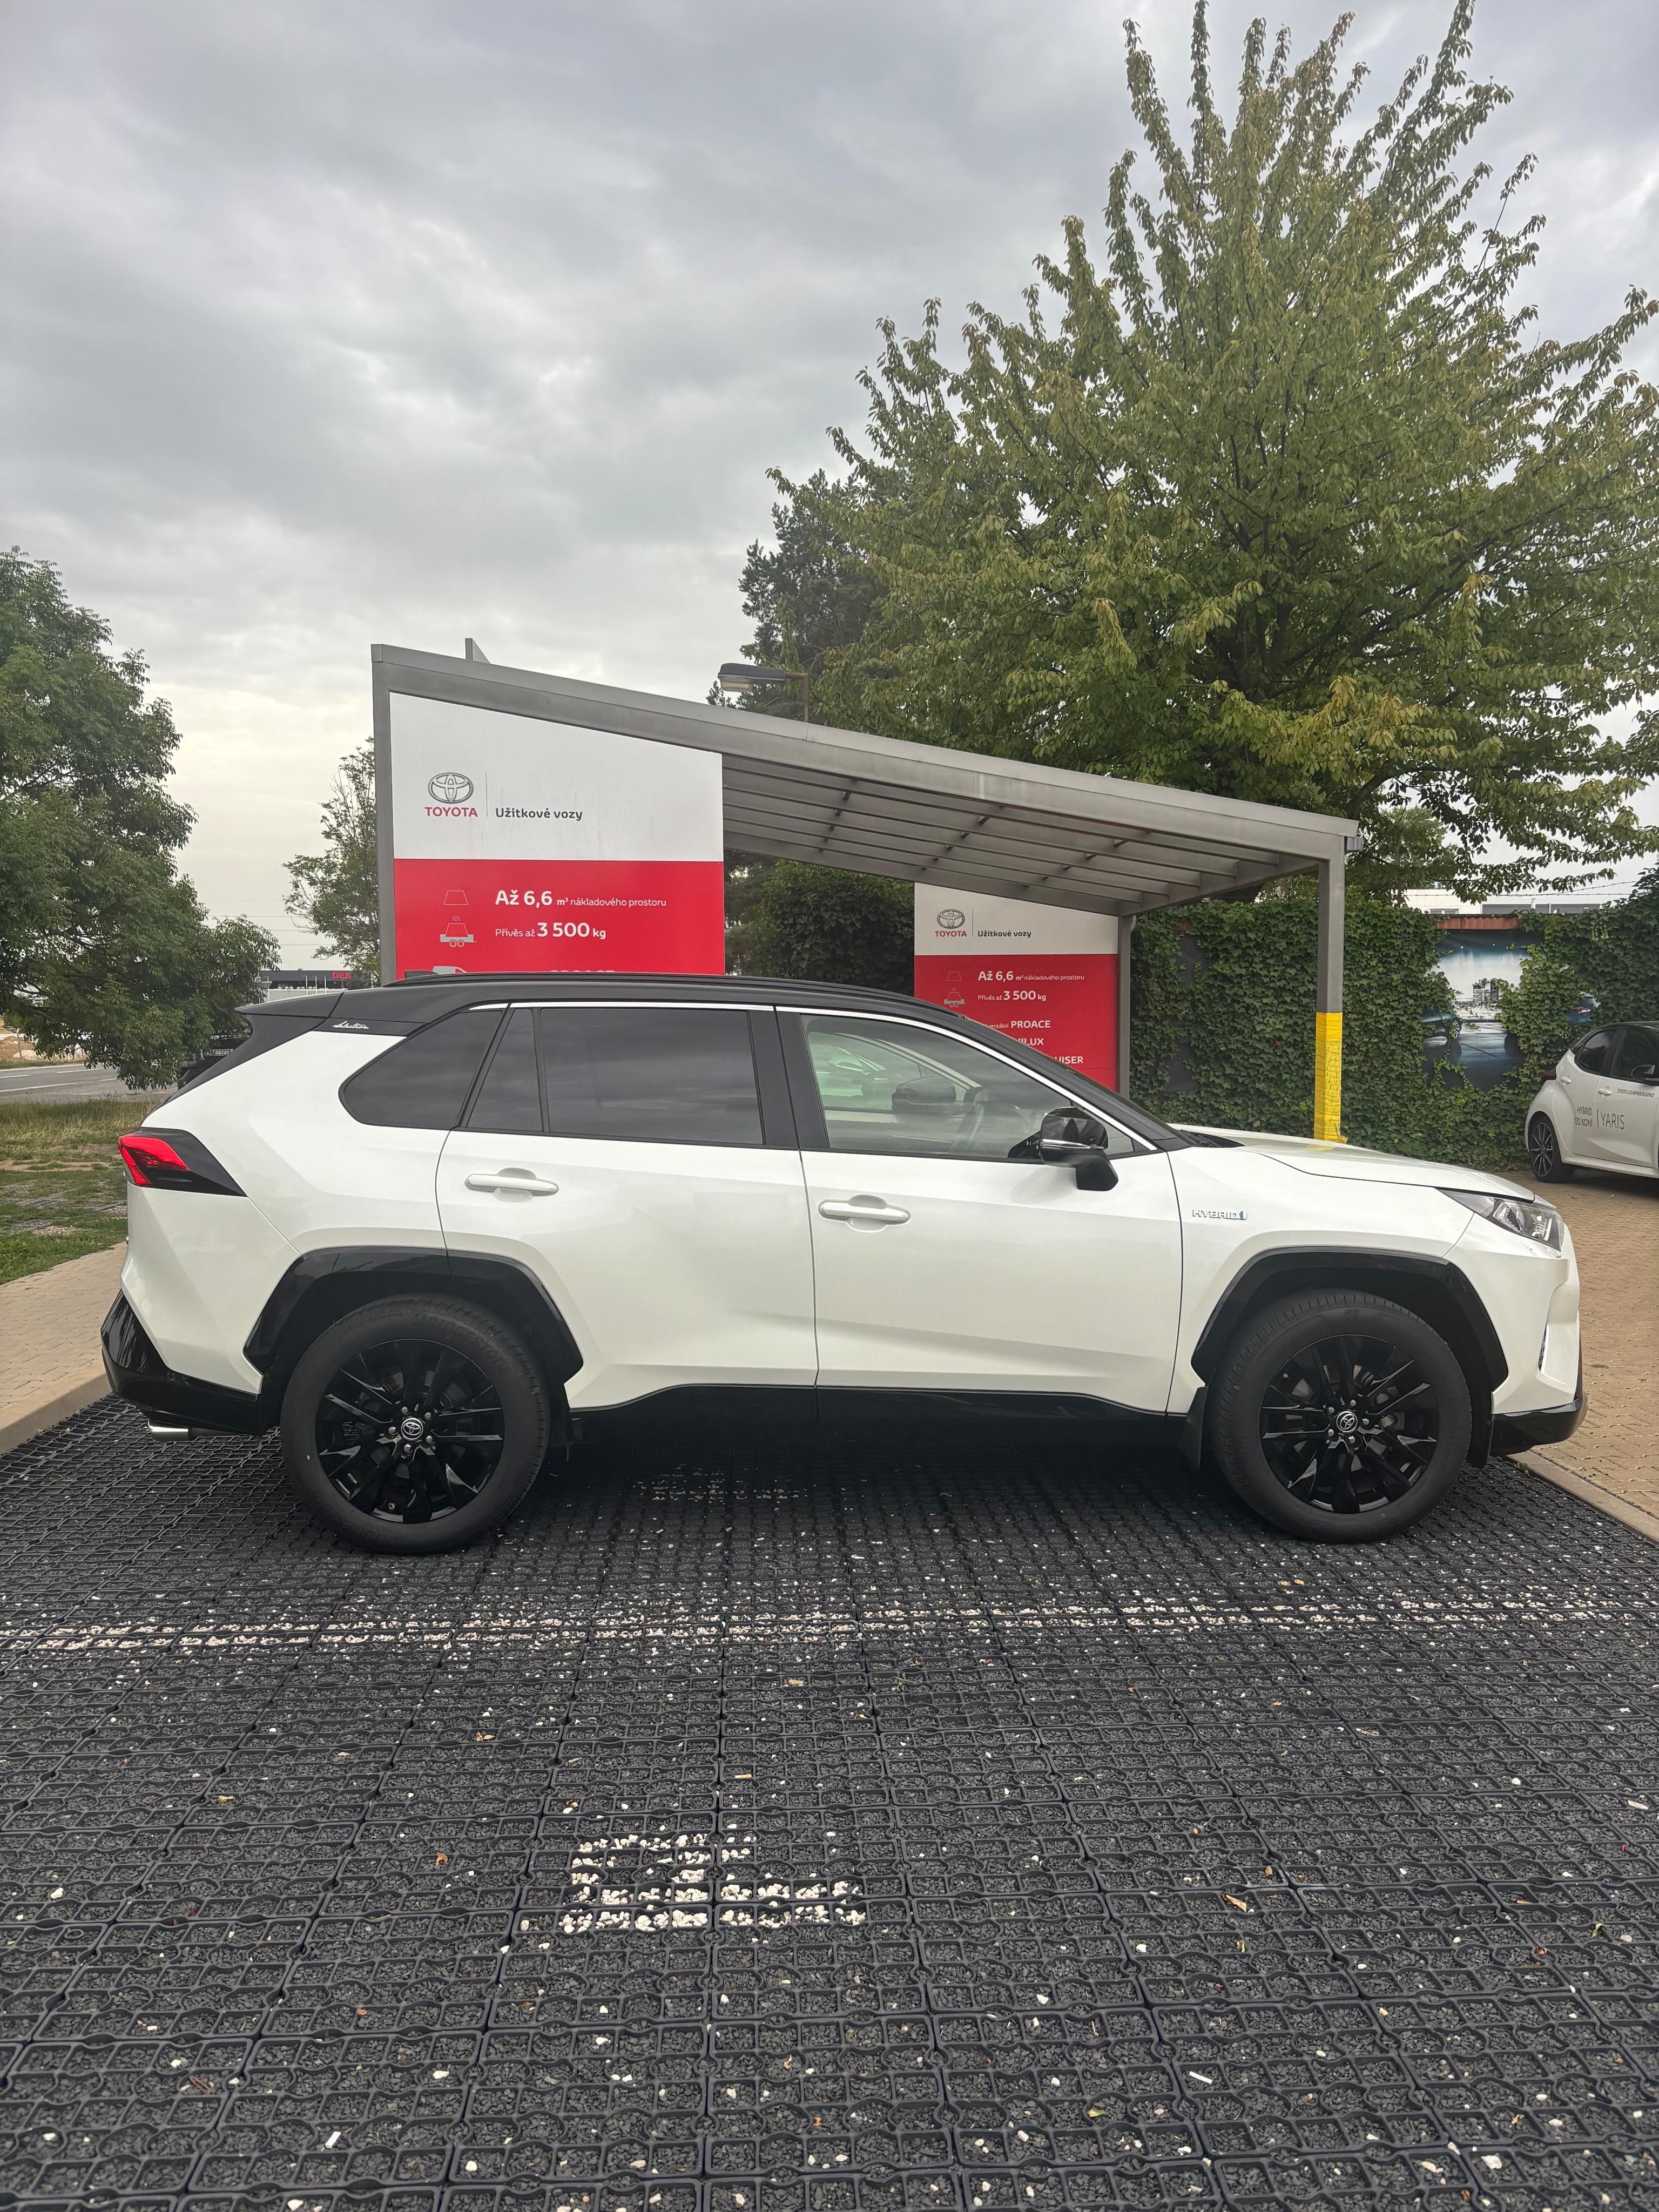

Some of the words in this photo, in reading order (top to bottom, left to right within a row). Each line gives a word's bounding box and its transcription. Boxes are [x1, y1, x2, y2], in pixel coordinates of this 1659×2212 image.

[424, 807, 478, 817] TOYOTA
[496, 807, 550, 818] Užitkové
[554, 811, 583, 821] vozy
[495, 889, 519, 905] Až
[524, 891, 552, 908] 6,6
[570, 898, 627, 906] nákladového
[629, 899, 666, 908] prostoru
[495, 928, 523, 938] Přívěs
[525, 928, 535, 938] až
[537, 922, 548, 938] 3
[552, 922, 590, 938] 500
[593, 928, 606, 940] kg
[978, 970, 993, 981] Až
[995, 971, 1013, 982] 6,6
[1003, 990, 1010, 1001] 3
[1013, 990, 1036, 1001] 500
[1037, 994, 1046, 1002] kg
[1011, 1020, 1051, 1029] PROACE
[1018, 1038, 1044, 1046] ILUX
[1576, 1106, 1593, 1116] HYBRID
[1601, 1112, 1625, 1129] YARIS
[1192, 1209, 1239, 1220] HYBRID
